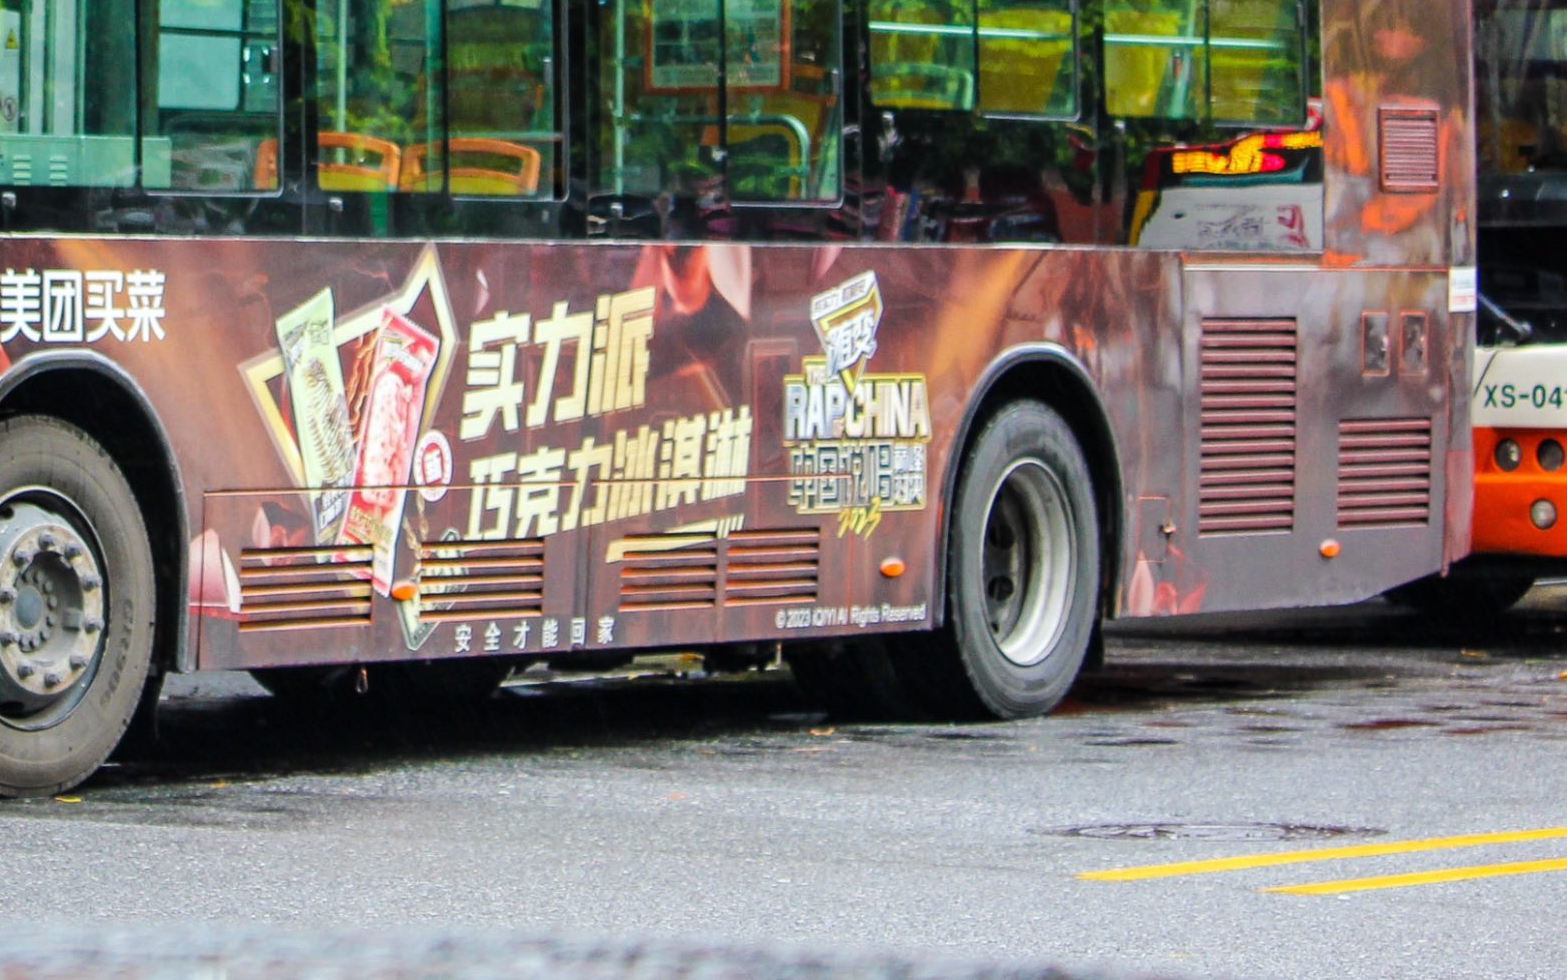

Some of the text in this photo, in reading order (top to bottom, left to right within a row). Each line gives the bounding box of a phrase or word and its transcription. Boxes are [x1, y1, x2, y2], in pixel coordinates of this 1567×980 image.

[459, 285, 658, 441] 实力派
[845, 380, 932, 439] CHINA
[1484, 384, 1567, 409] XS-04
[464, 404, 754, 542] 巧克力冰淇淋
[454, 616, 615, 653] 安全才能回家
